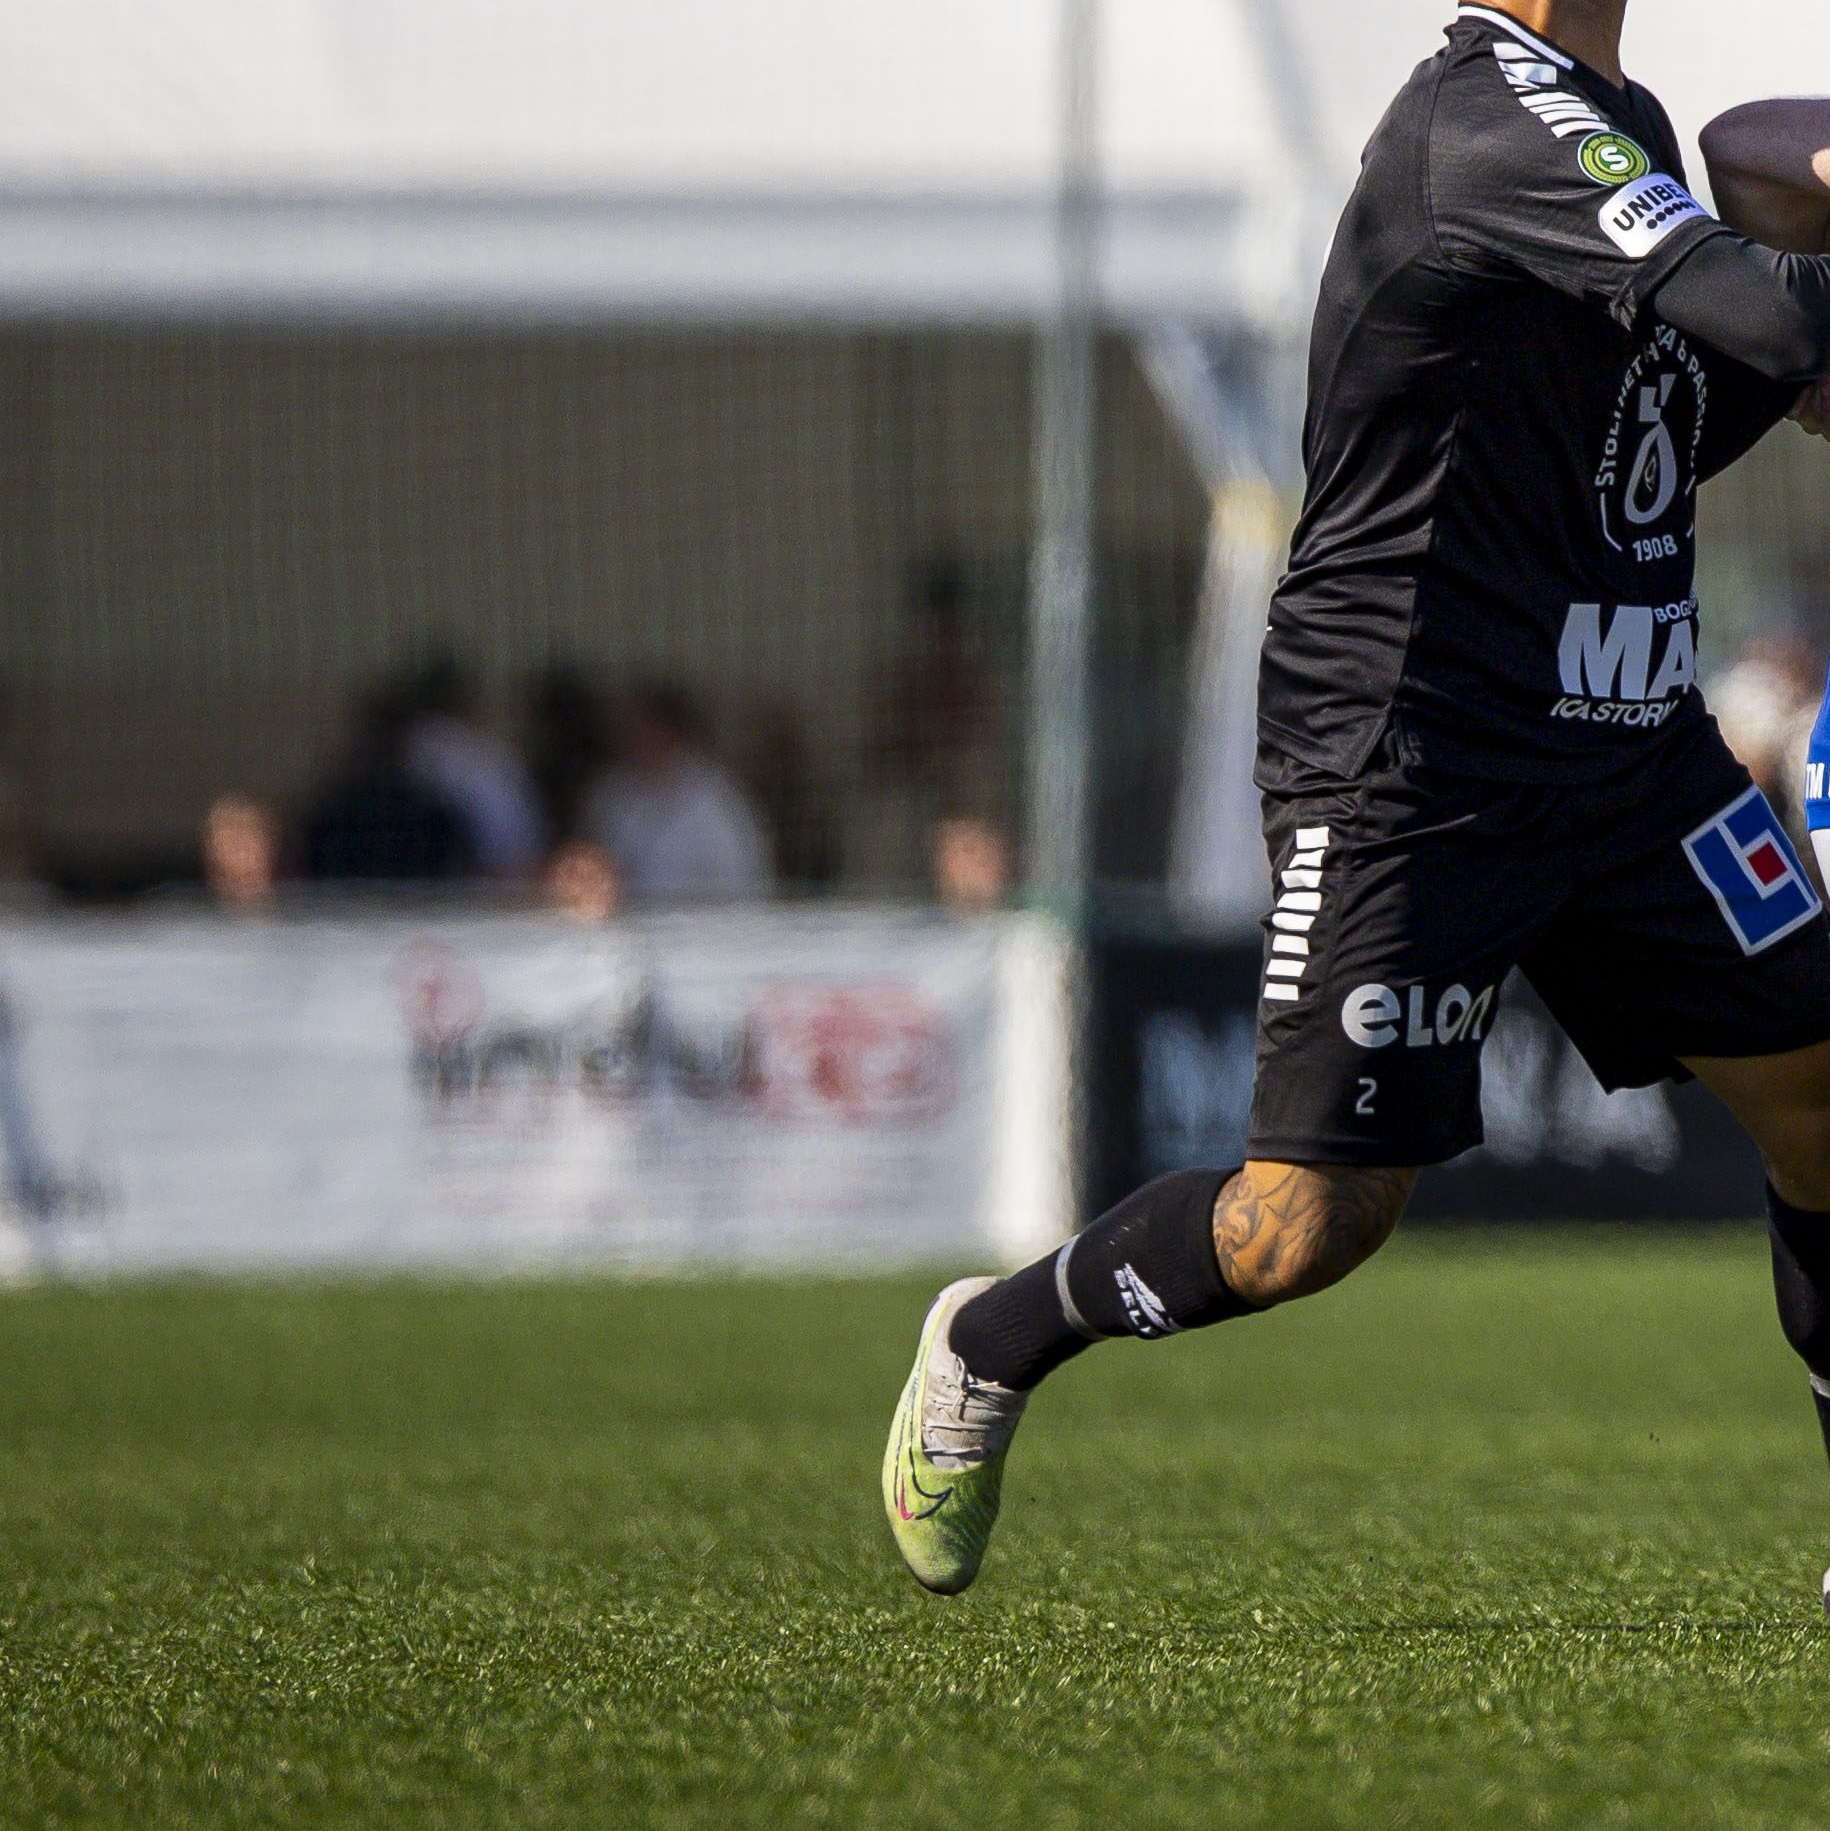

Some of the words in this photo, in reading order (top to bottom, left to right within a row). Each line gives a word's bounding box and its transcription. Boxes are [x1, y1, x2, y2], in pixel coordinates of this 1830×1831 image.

[1613, 182, 1685, 232] UNIBE
[1632, 533, 1680, 563] 1908
[1558, 603, 1698, 701] MA
[1550, 697, 1591, 721] ICA
[1355, 1077, 1378, 1115] 2
[1113, 1269, 1152, 1334] SEL
